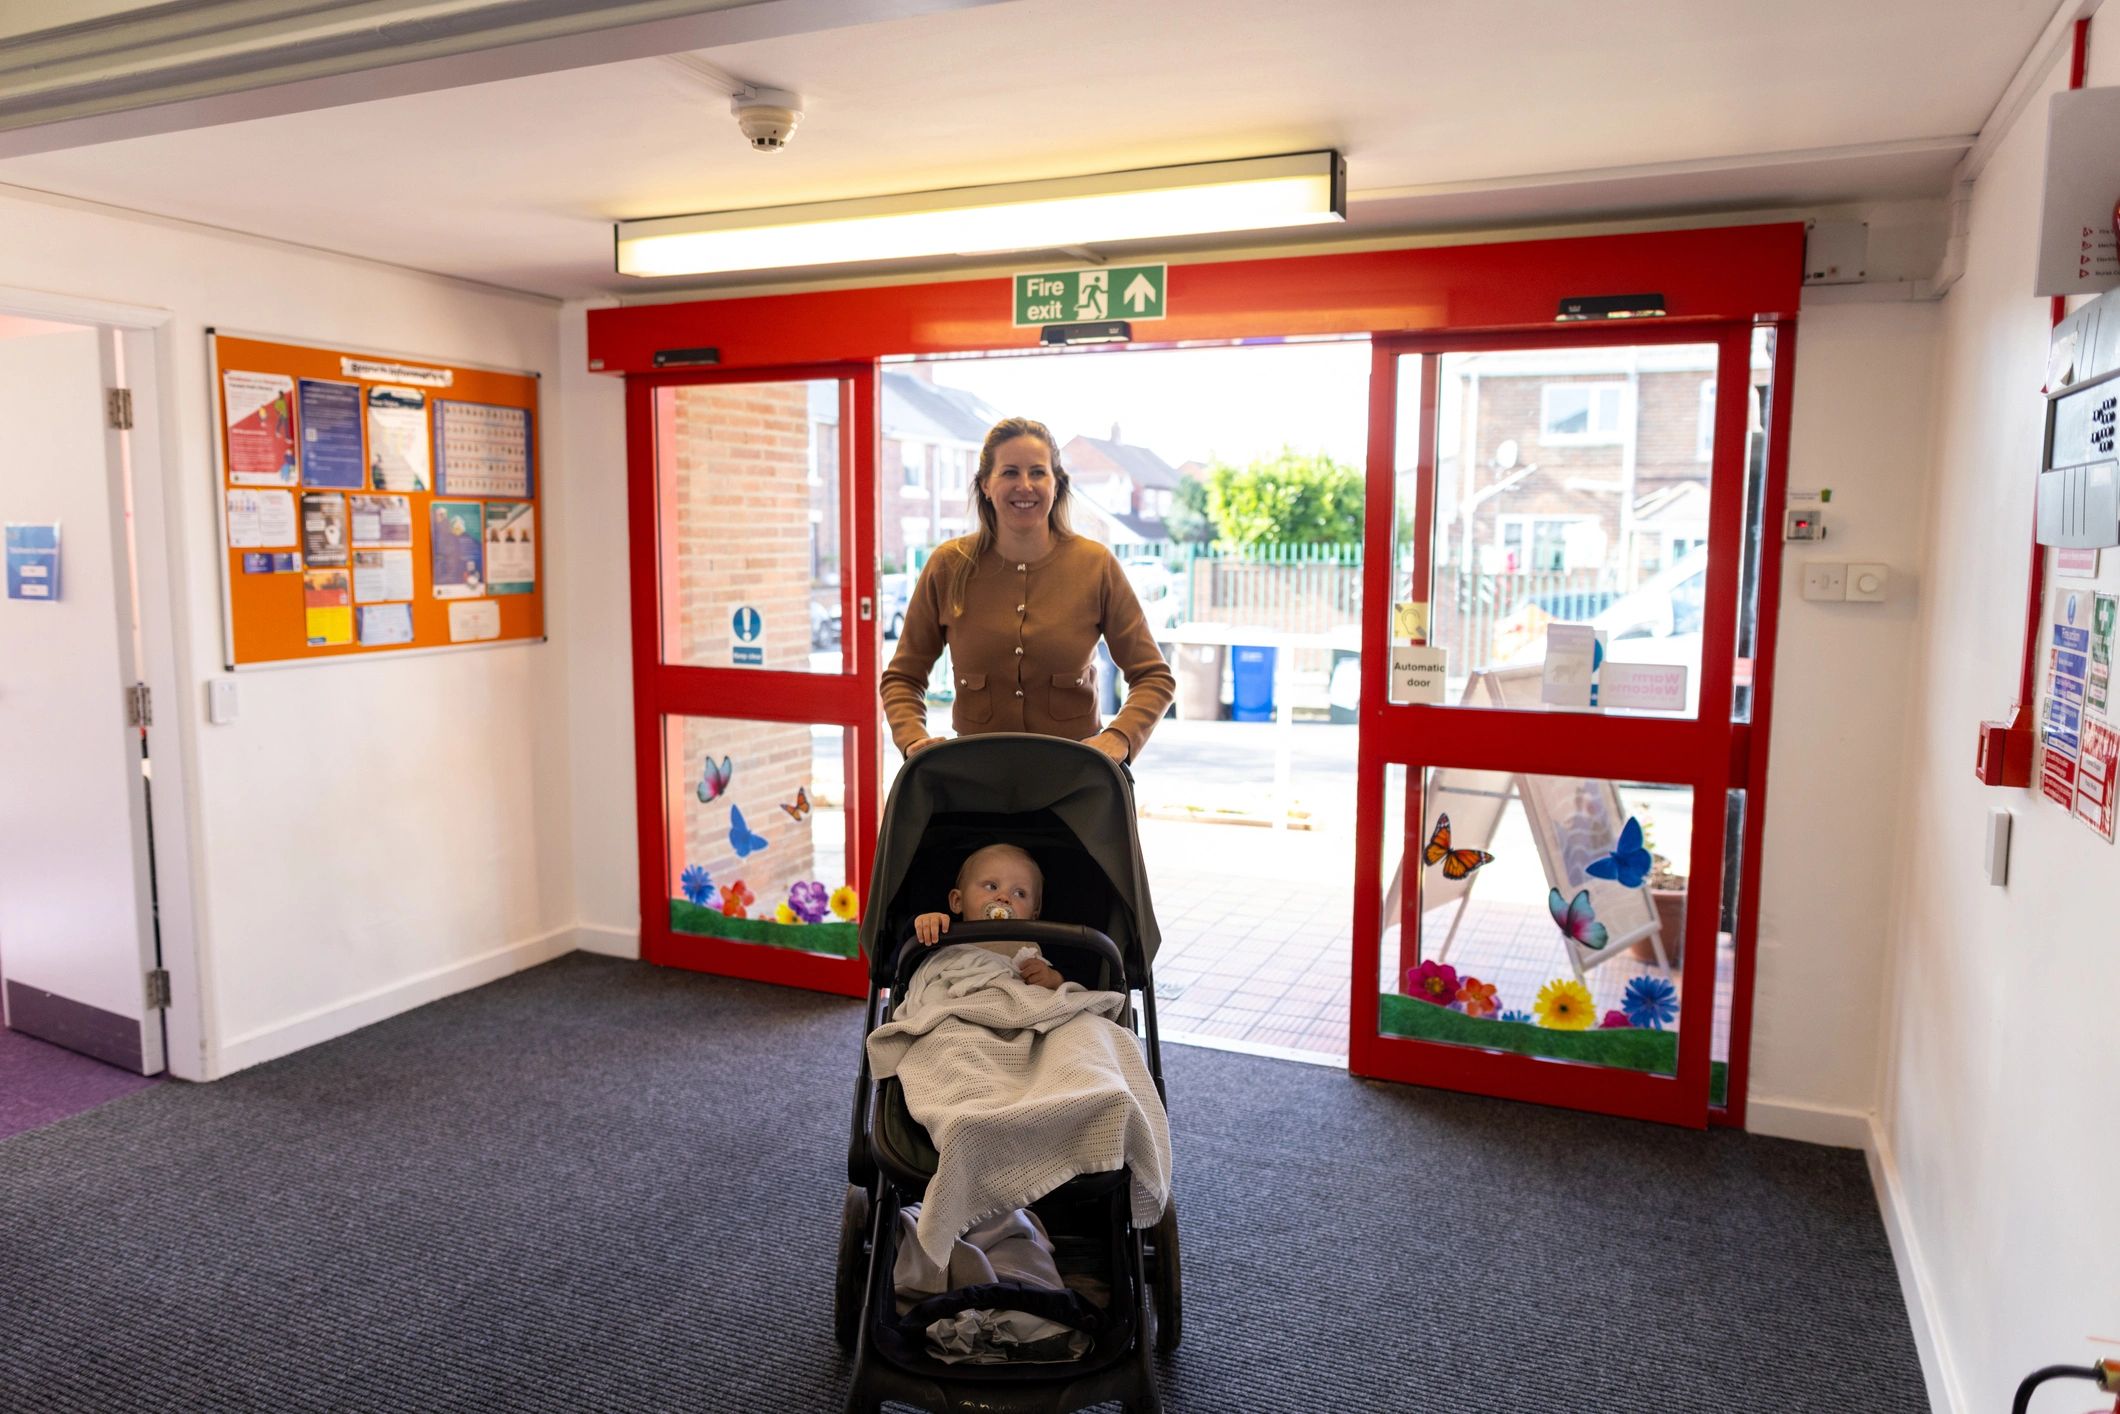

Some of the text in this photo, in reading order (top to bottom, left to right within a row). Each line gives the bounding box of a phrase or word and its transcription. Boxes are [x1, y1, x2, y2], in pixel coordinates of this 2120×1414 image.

[1027, 278, 1065, 298] Fire
[1026, 300, 1063, 320] exit
[1394, 662, 1446, 673] Automatic
[1407, 677, 1431, 688] door
